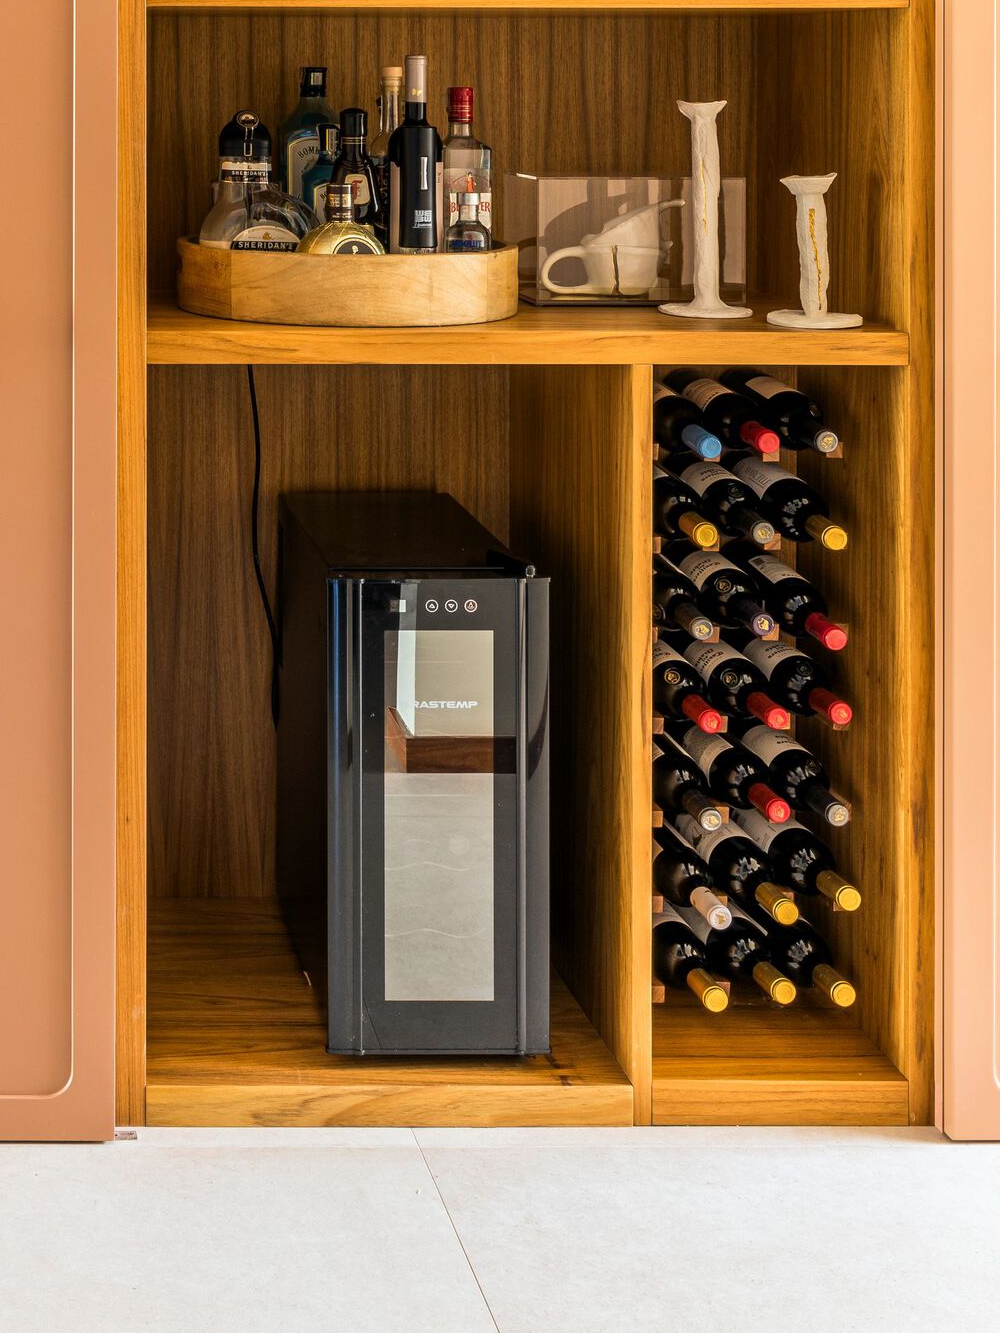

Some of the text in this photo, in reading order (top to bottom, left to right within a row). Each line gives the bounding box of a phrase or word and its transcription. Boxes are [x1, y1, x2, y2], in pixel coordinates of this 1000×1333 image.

[297, 146, 320, 159] BOMB
[237, 241, 293, 250] SHERIDAN'S
[410, 700, 478, 709] RASTEMP
